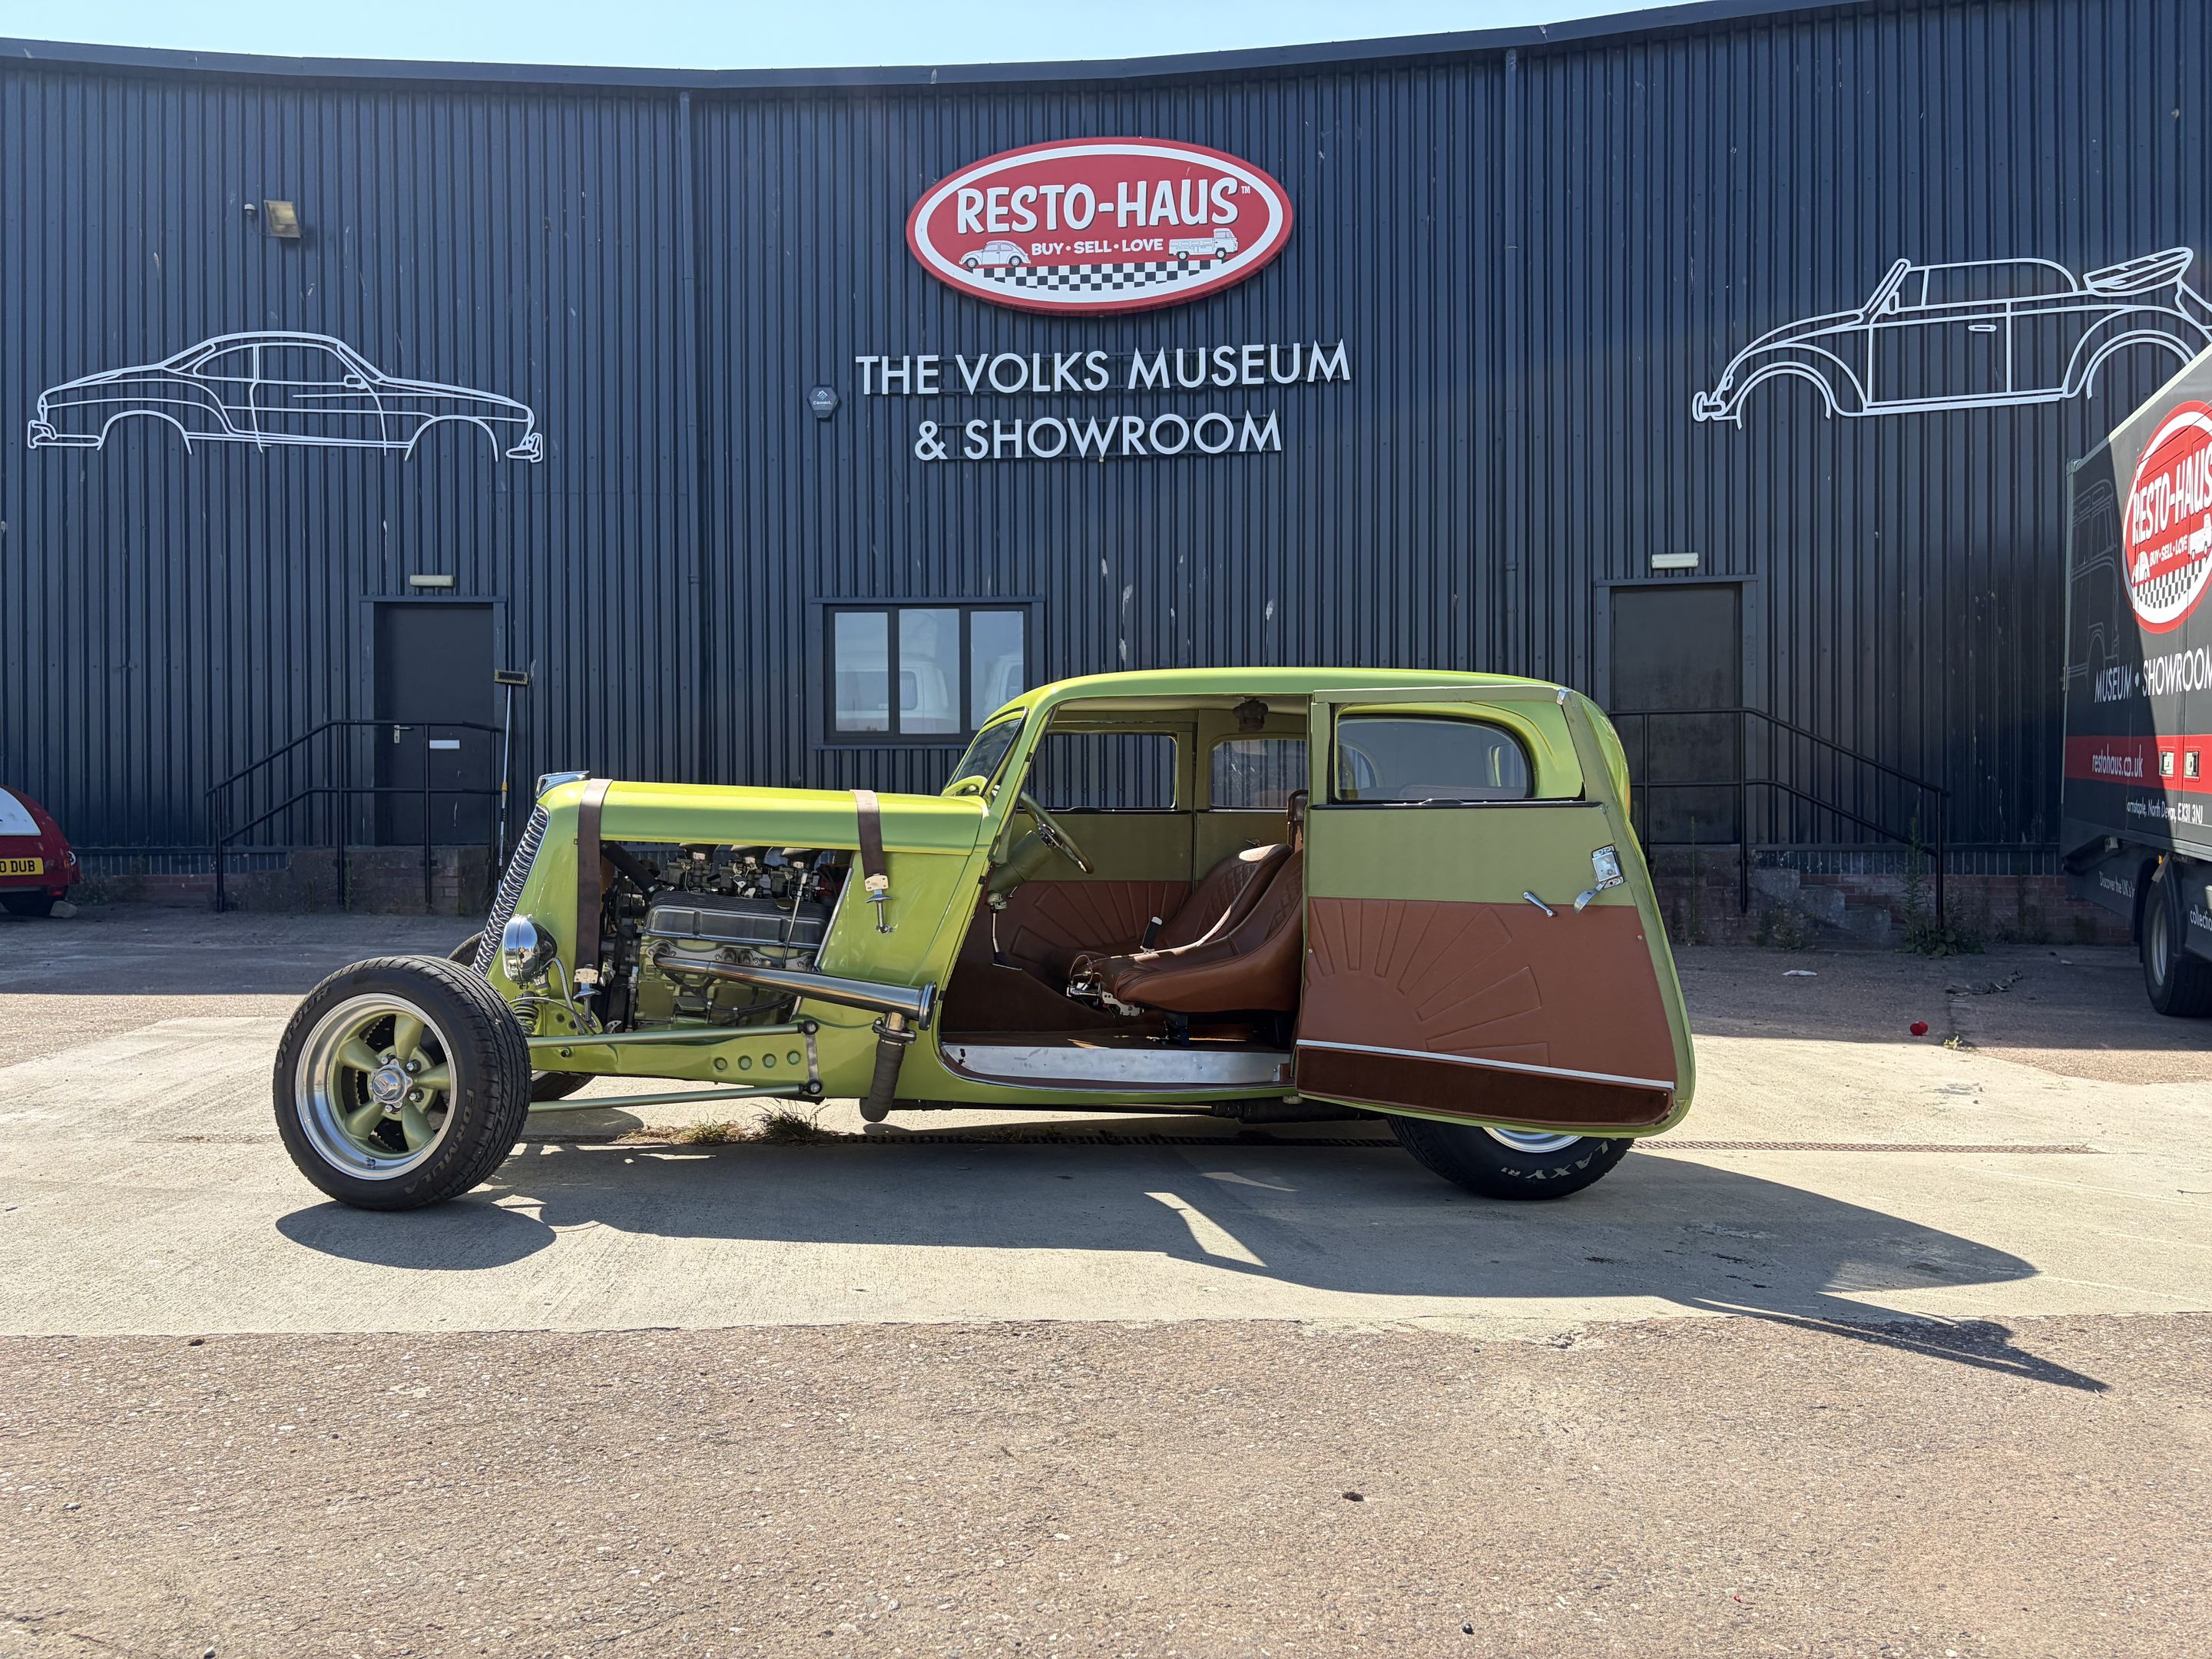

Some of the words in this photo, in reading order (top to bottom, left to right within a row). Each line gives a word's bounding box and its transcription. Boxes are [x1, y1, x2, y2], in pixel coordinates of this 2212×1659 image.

[958, 177, 1238, 234] RESTO-HAUS
[1031, 243, 1064, 256] BUY
[1074, 240, 1112, 254] SELL
[1121, 238, 1164, 252] LOVE
[855, 355, 939, 395] THE
[955, 350, 1109, 396] VOLKS
[1128, 338, 1350, 390] MUSEUM
[915, 420, 949, 461] &
[964, 409, 1282, 461] SHOWROOM
[2132, 441, 2212, 547] RESTO-HAUS
[2150, 549, 2160, 567] BUY
[2161, 541, 2173, 561] SELL
[2094, 663, 2132, 704] MUSEUM
[2092, 743, 2143, 778] restohaus.co.uk
[11, 860, 35, 873] DUB
[404, 1088, 475, 1194] FORMULA
[1525, 1138, 1617, 1179] LAXY
